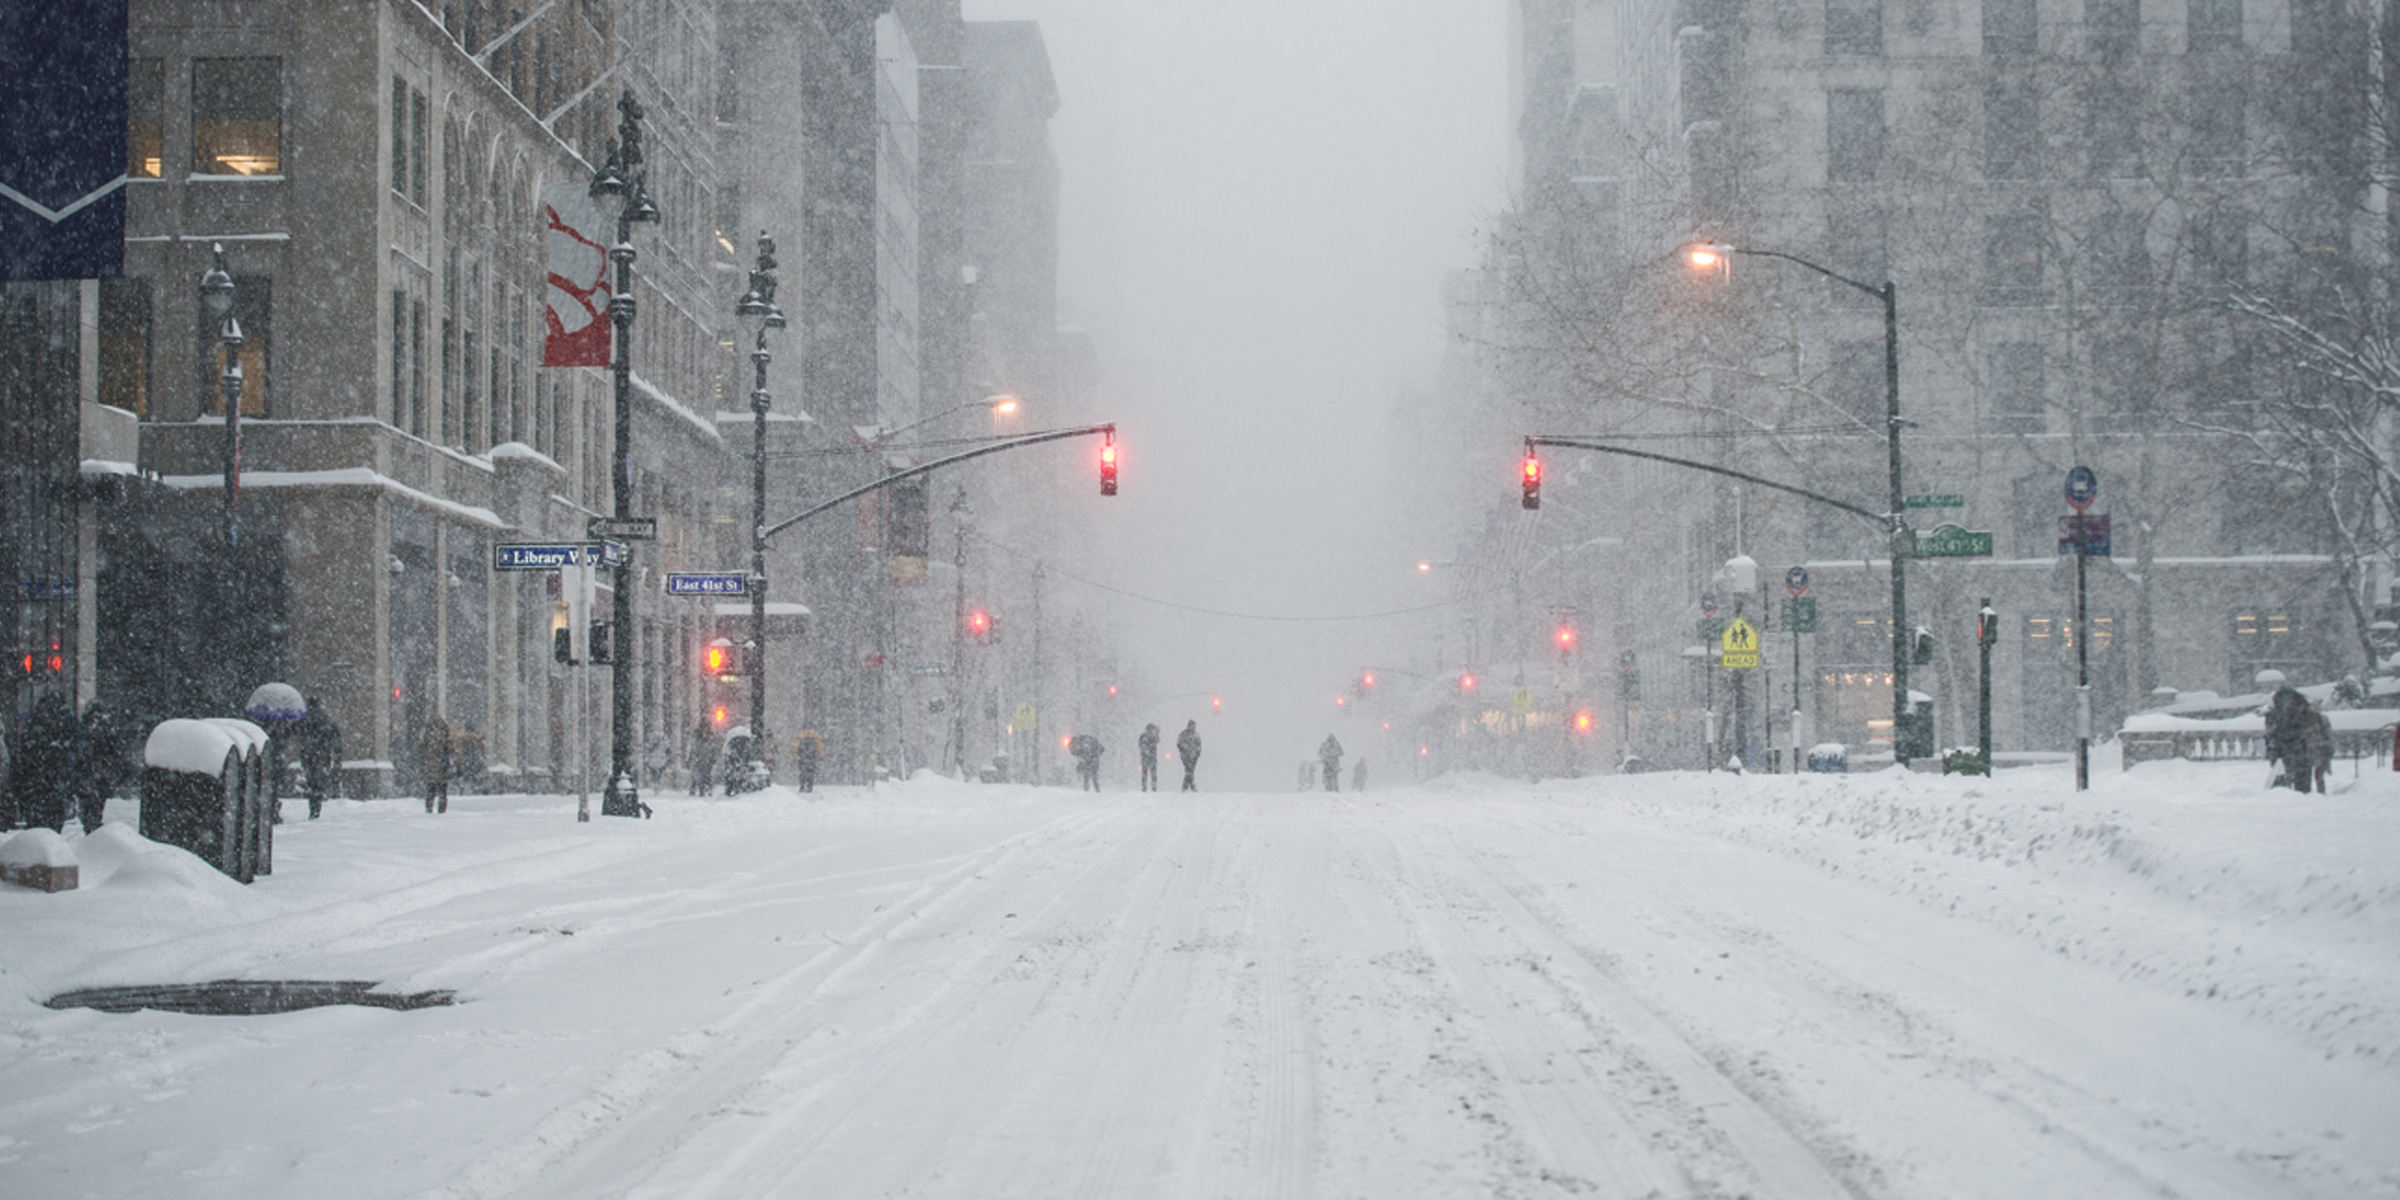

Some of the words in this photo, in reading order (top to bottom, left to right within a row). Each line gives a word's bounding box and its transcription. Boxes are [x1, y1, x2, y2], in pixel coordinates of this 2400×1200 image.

[513, 550, 565, 567] Library
[675, 580, 700, 591] East
[702, 580, 724, 591] 41st
[726, 580, 738, 591] St
[1725, 655, 1755, 665] AHEAD
